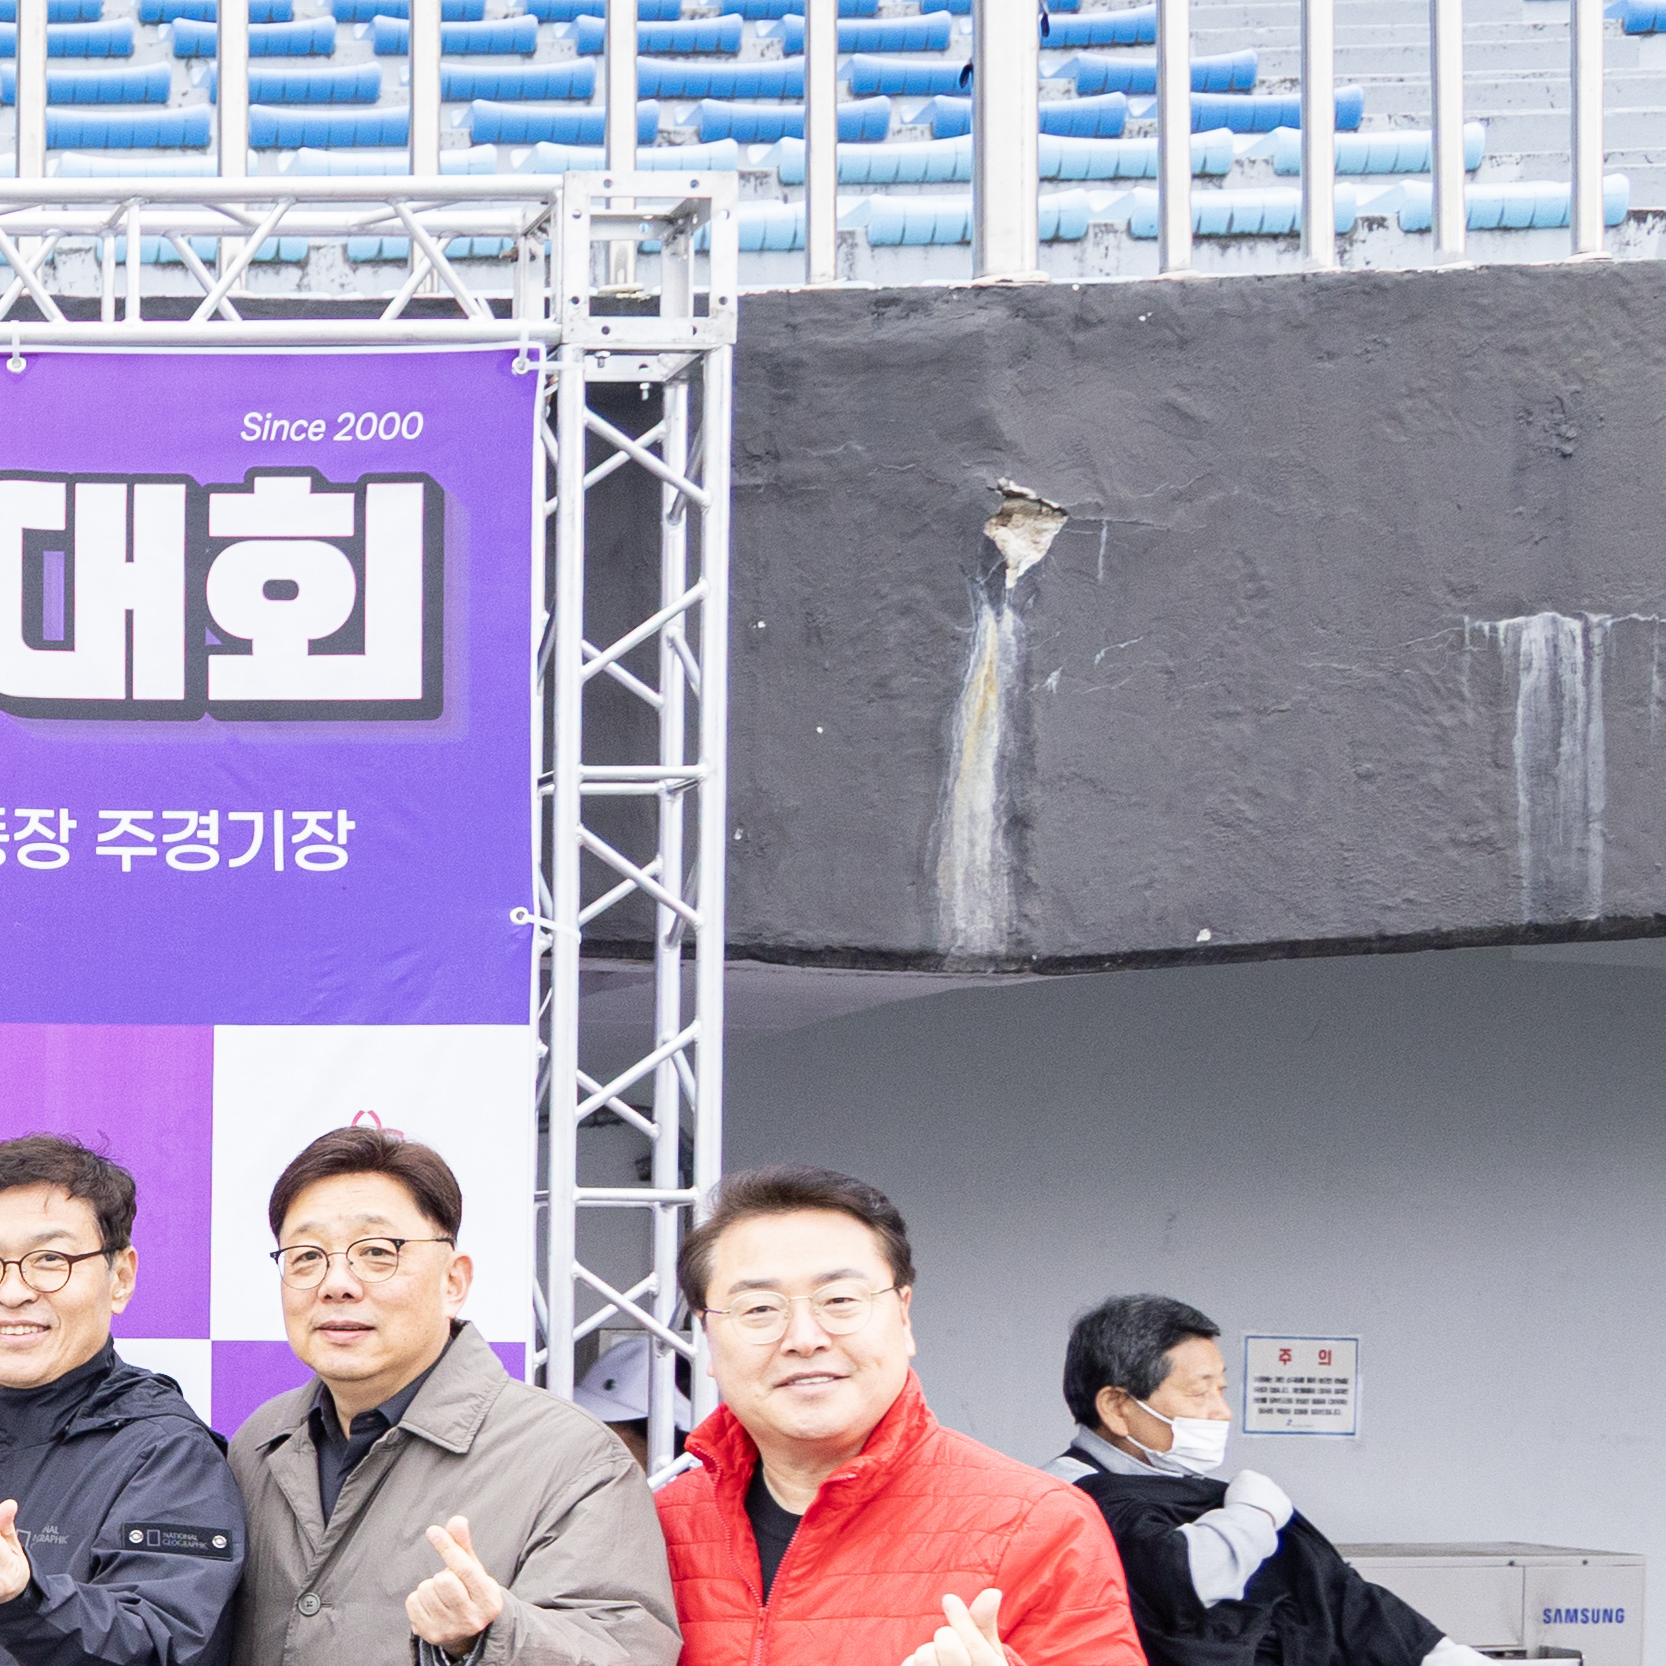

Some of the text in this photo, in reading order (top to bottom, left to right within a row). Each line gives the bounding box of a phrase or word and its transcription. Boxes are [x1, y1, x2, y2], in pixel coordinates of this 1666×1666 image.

[240, 411, 424, 441] Since 2000
[94, 808, 356, 872] 주경기장
[1542, 1607, 1625, 1624] SAMSUNG
